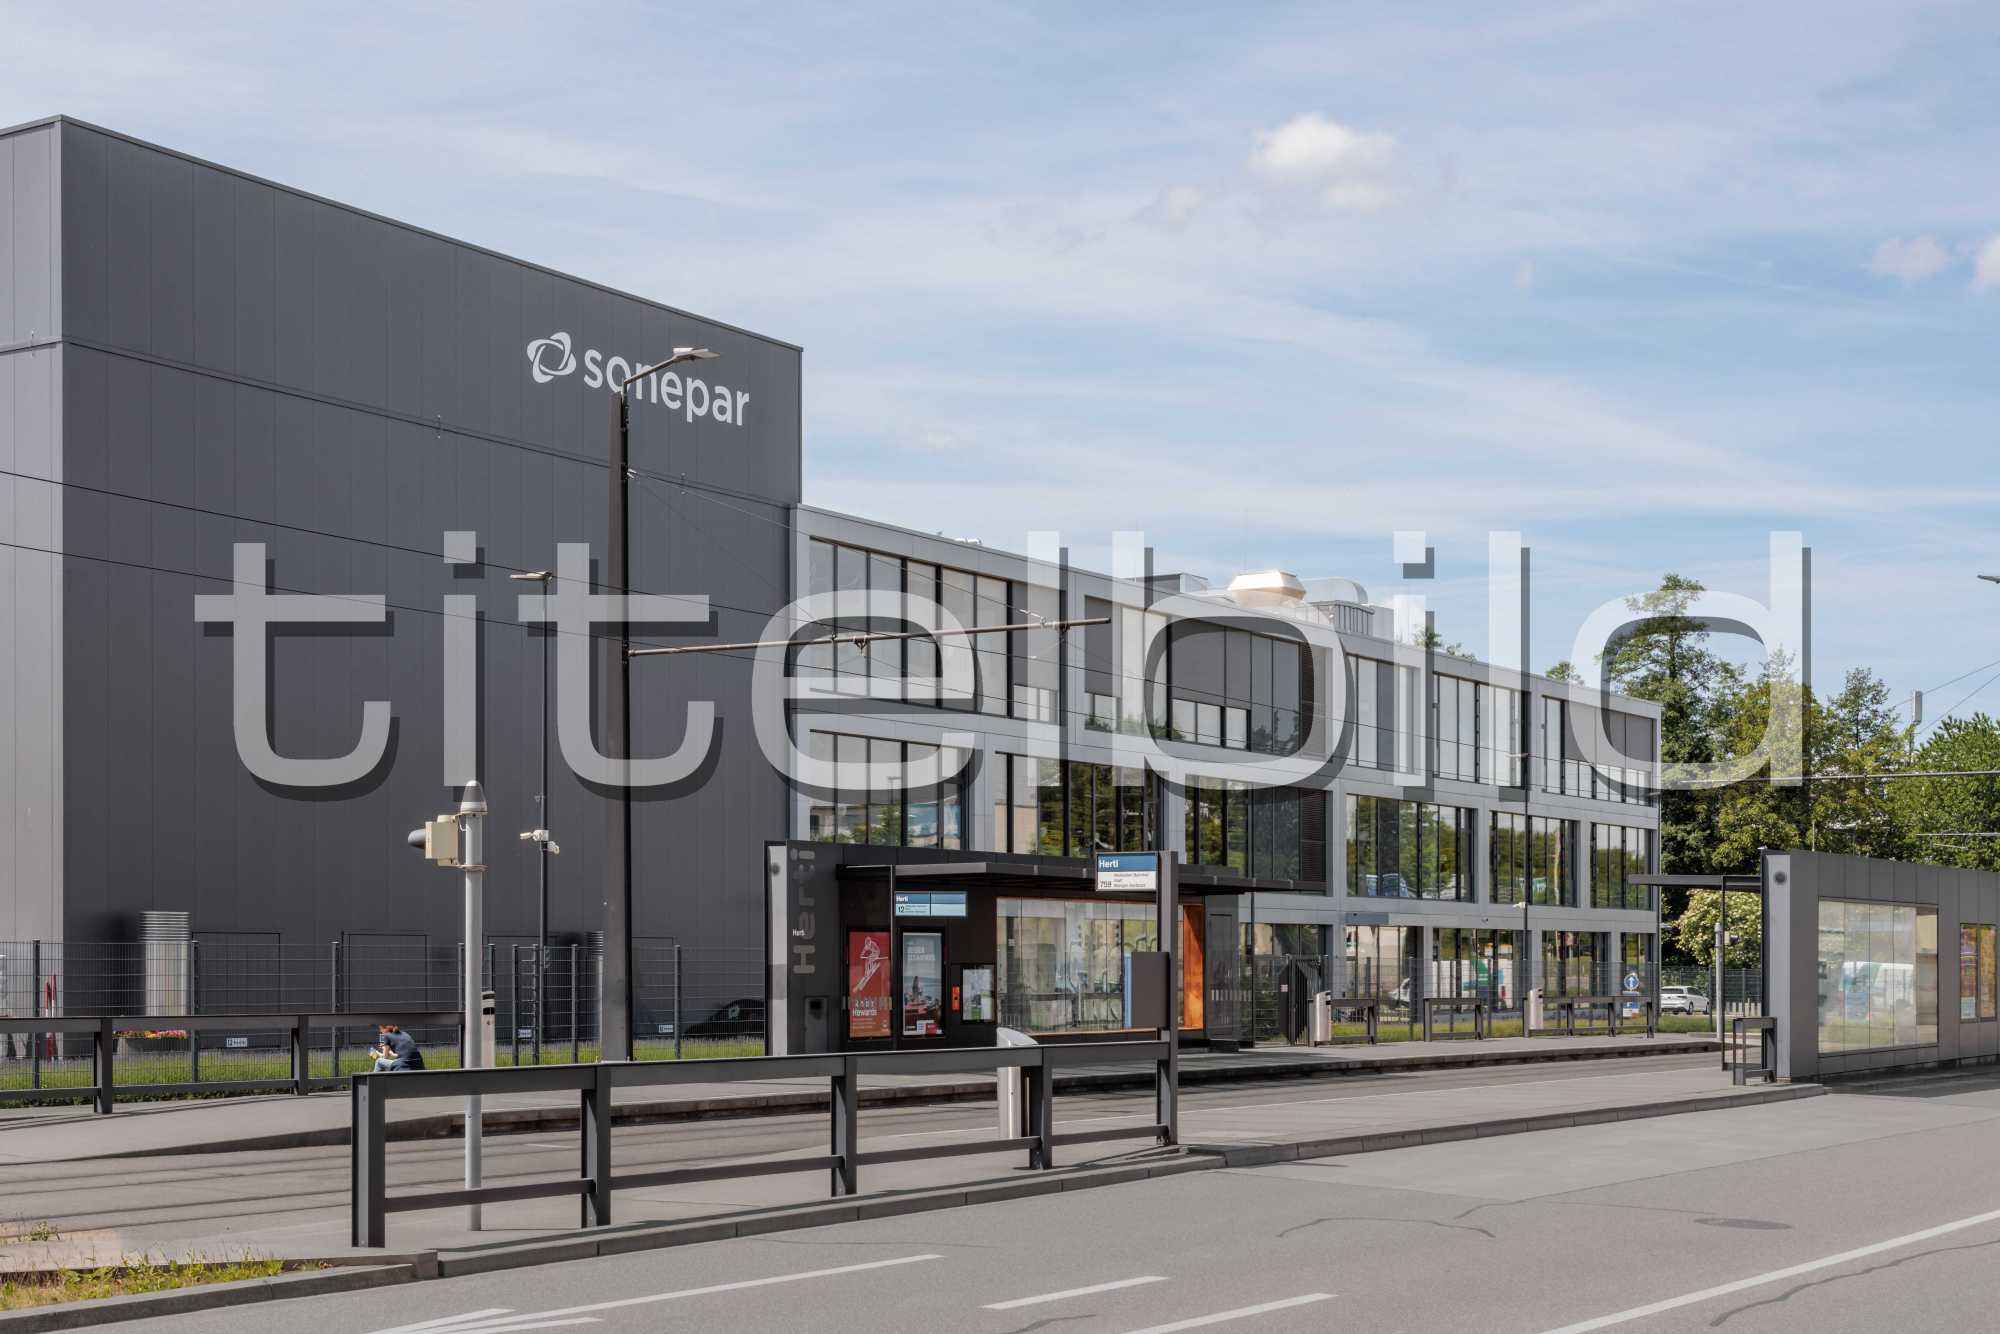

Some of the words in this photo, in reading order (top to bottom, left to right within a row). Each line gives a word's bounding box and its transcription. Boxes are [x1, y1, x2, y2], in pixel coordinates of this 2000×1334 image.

[583, 348, 750, 426] sonepar
[1099, 859, 1119, 868] Herti
[790, 847, 816, 974] Herti
[898, 905, 905, 913] 12
